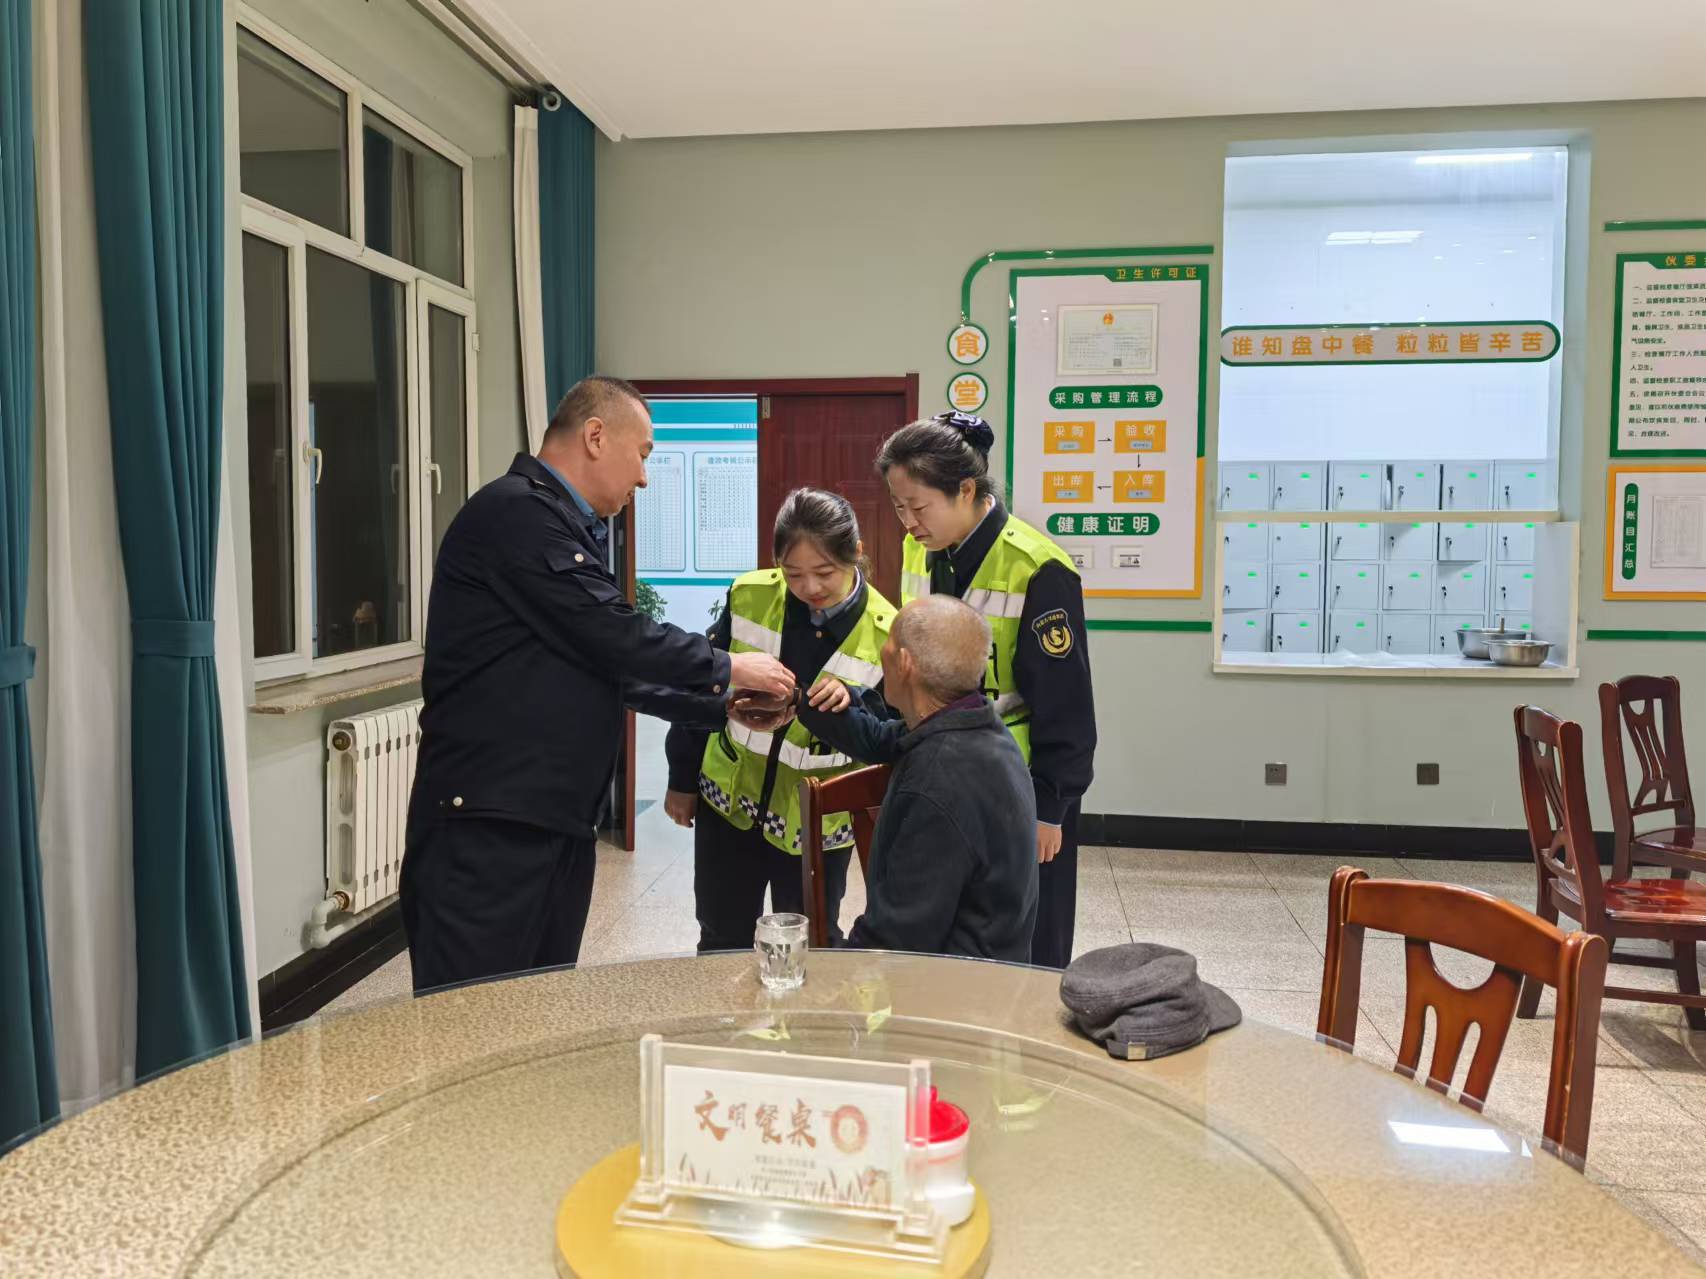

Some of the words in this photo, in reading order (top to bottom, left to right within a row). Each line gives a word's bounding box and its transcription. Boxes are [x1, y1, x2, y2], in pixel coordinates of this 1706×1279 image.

[1665, 254, 1706, 267] 伙委
[1116, 266, 1197, 280] 卫生许可证
[1231, 332, 1374, 357] 谁知盘中餐
[1397, 331, 1544, 354] 粒粒皆辛苦
[954, 330, 981, 407] 食堂
[1054, 390, 1158, 405] 采购管理流程
[1053, 425, 1084, 437] 采购
[1125, 424, 1156, 437] 验收
[1052, 475, 1084, 487] 出库
[1124, 474, 1155, 487] 入库
[1056, 515, 1150, 534] 健康证明
[1623, 494, 1637, 569] 月账目汇总
[693, 1089, 817, 1149] 文明餐桌
